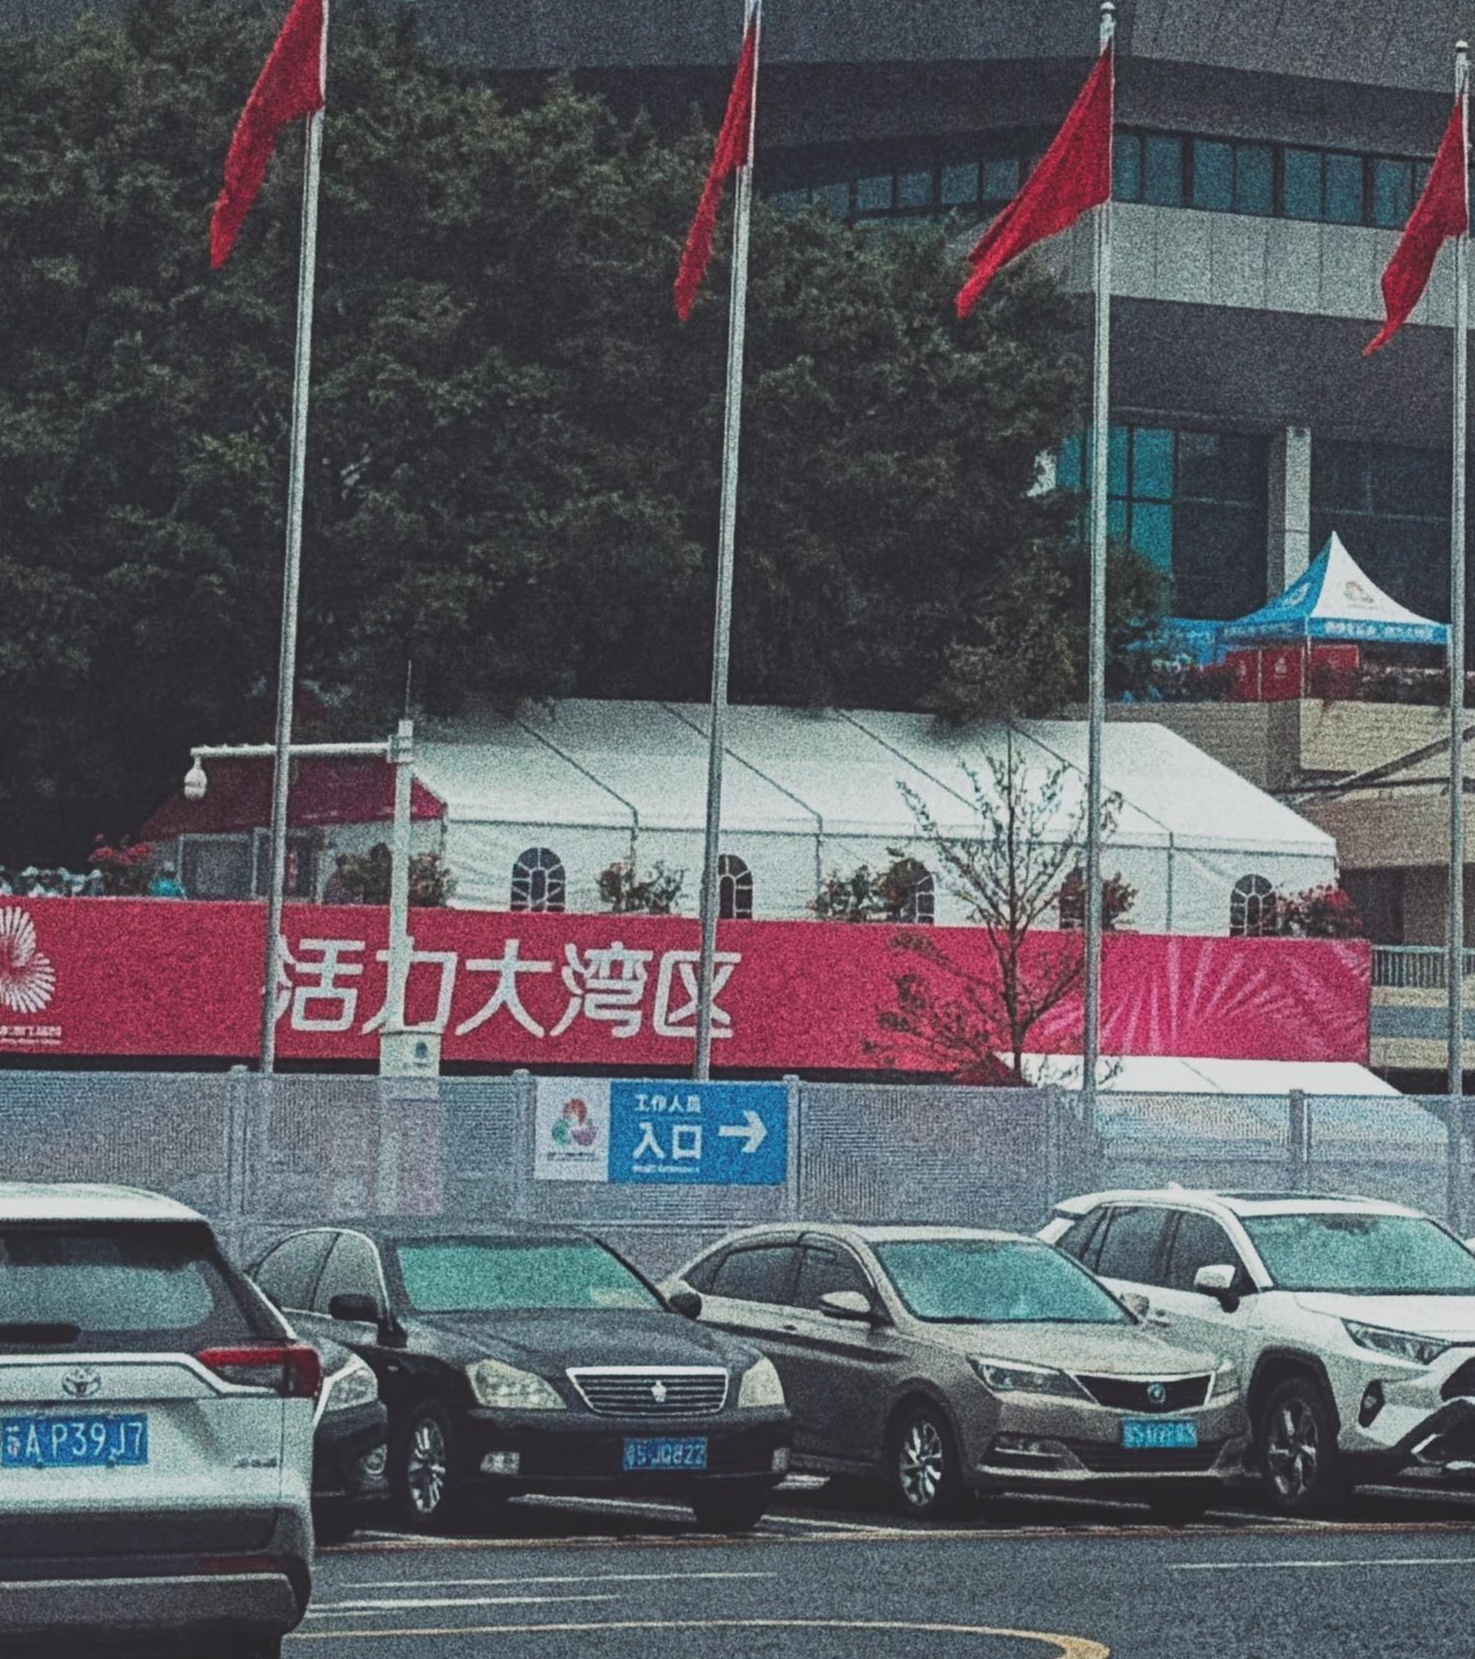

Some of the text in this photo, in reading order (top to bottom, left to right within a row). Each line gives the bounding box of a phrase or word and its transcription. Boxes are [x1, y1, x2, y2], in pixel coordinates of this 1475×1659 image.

[262, 933, 743, 1040] 活力大湾区
[634, 1092, 703, 1115] 工作人员
[632, 1121, 704, 1160] 入口
